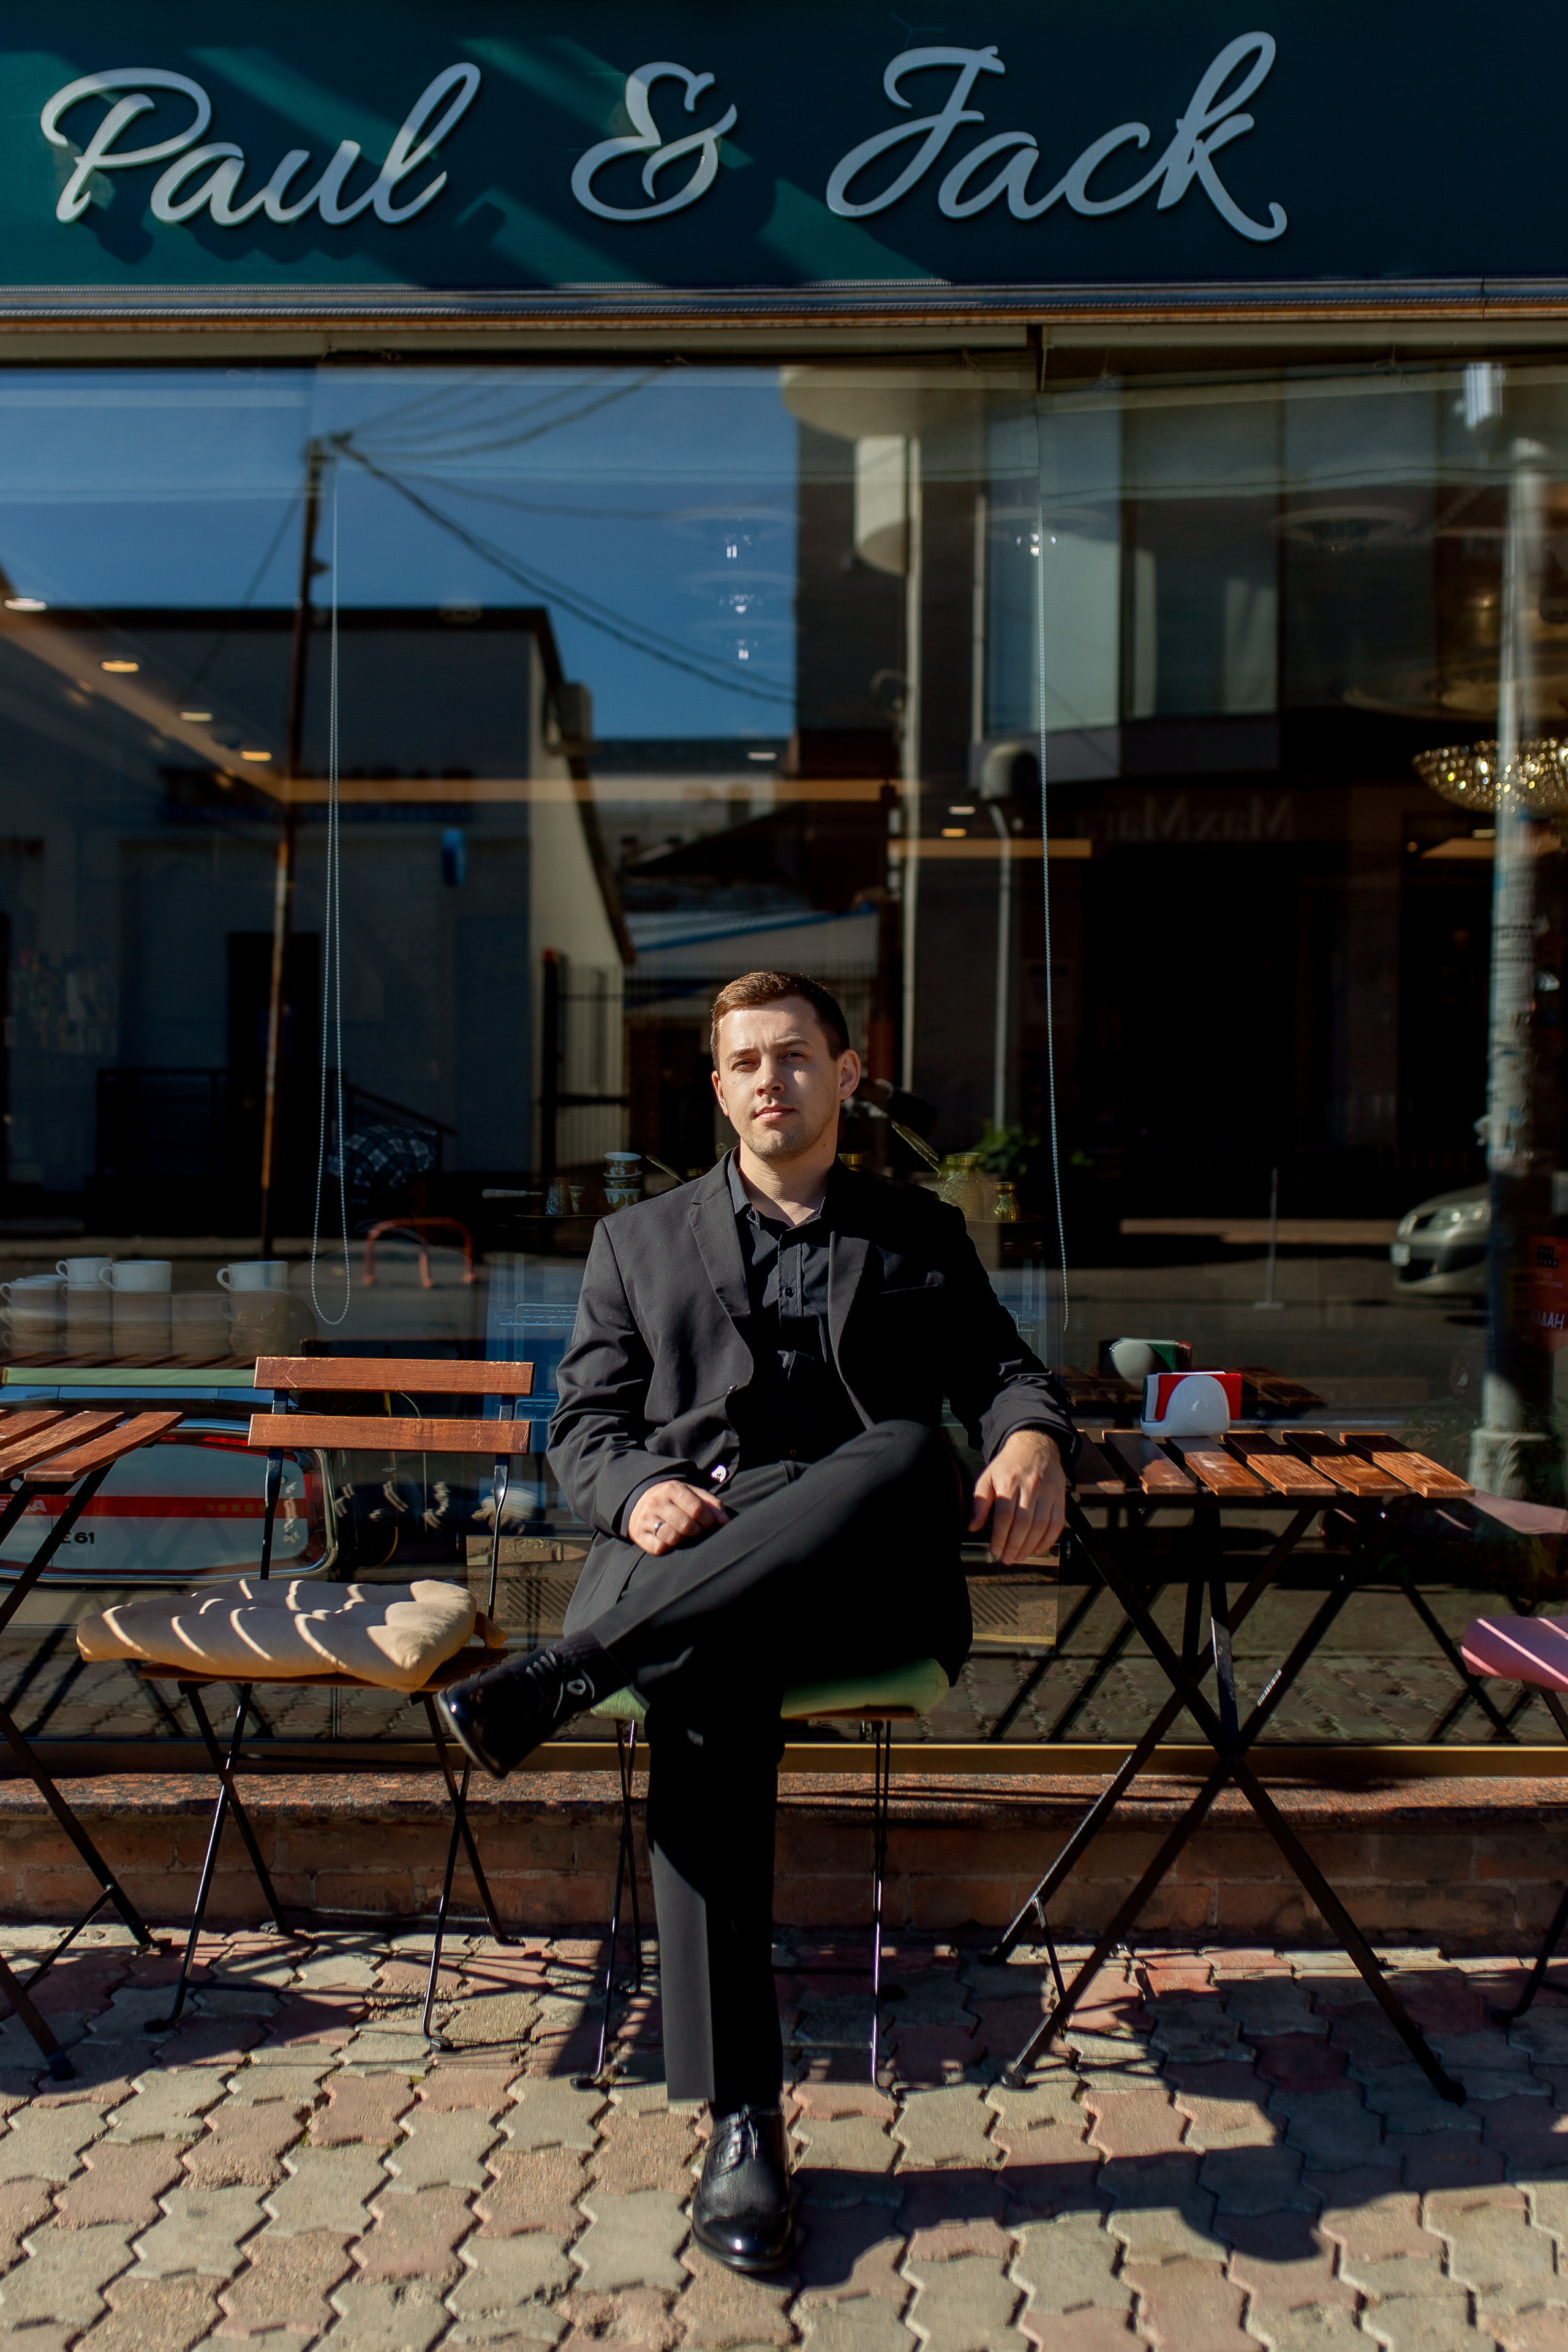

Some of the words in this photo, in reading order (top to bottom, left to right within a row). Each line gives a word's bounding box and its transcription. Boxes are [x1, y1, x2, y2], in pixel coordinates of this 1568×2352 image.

[40, 62, 481, 225] Paul
[571, 62, 736, 221] &
[827, 32, 1287, 239] Jack
